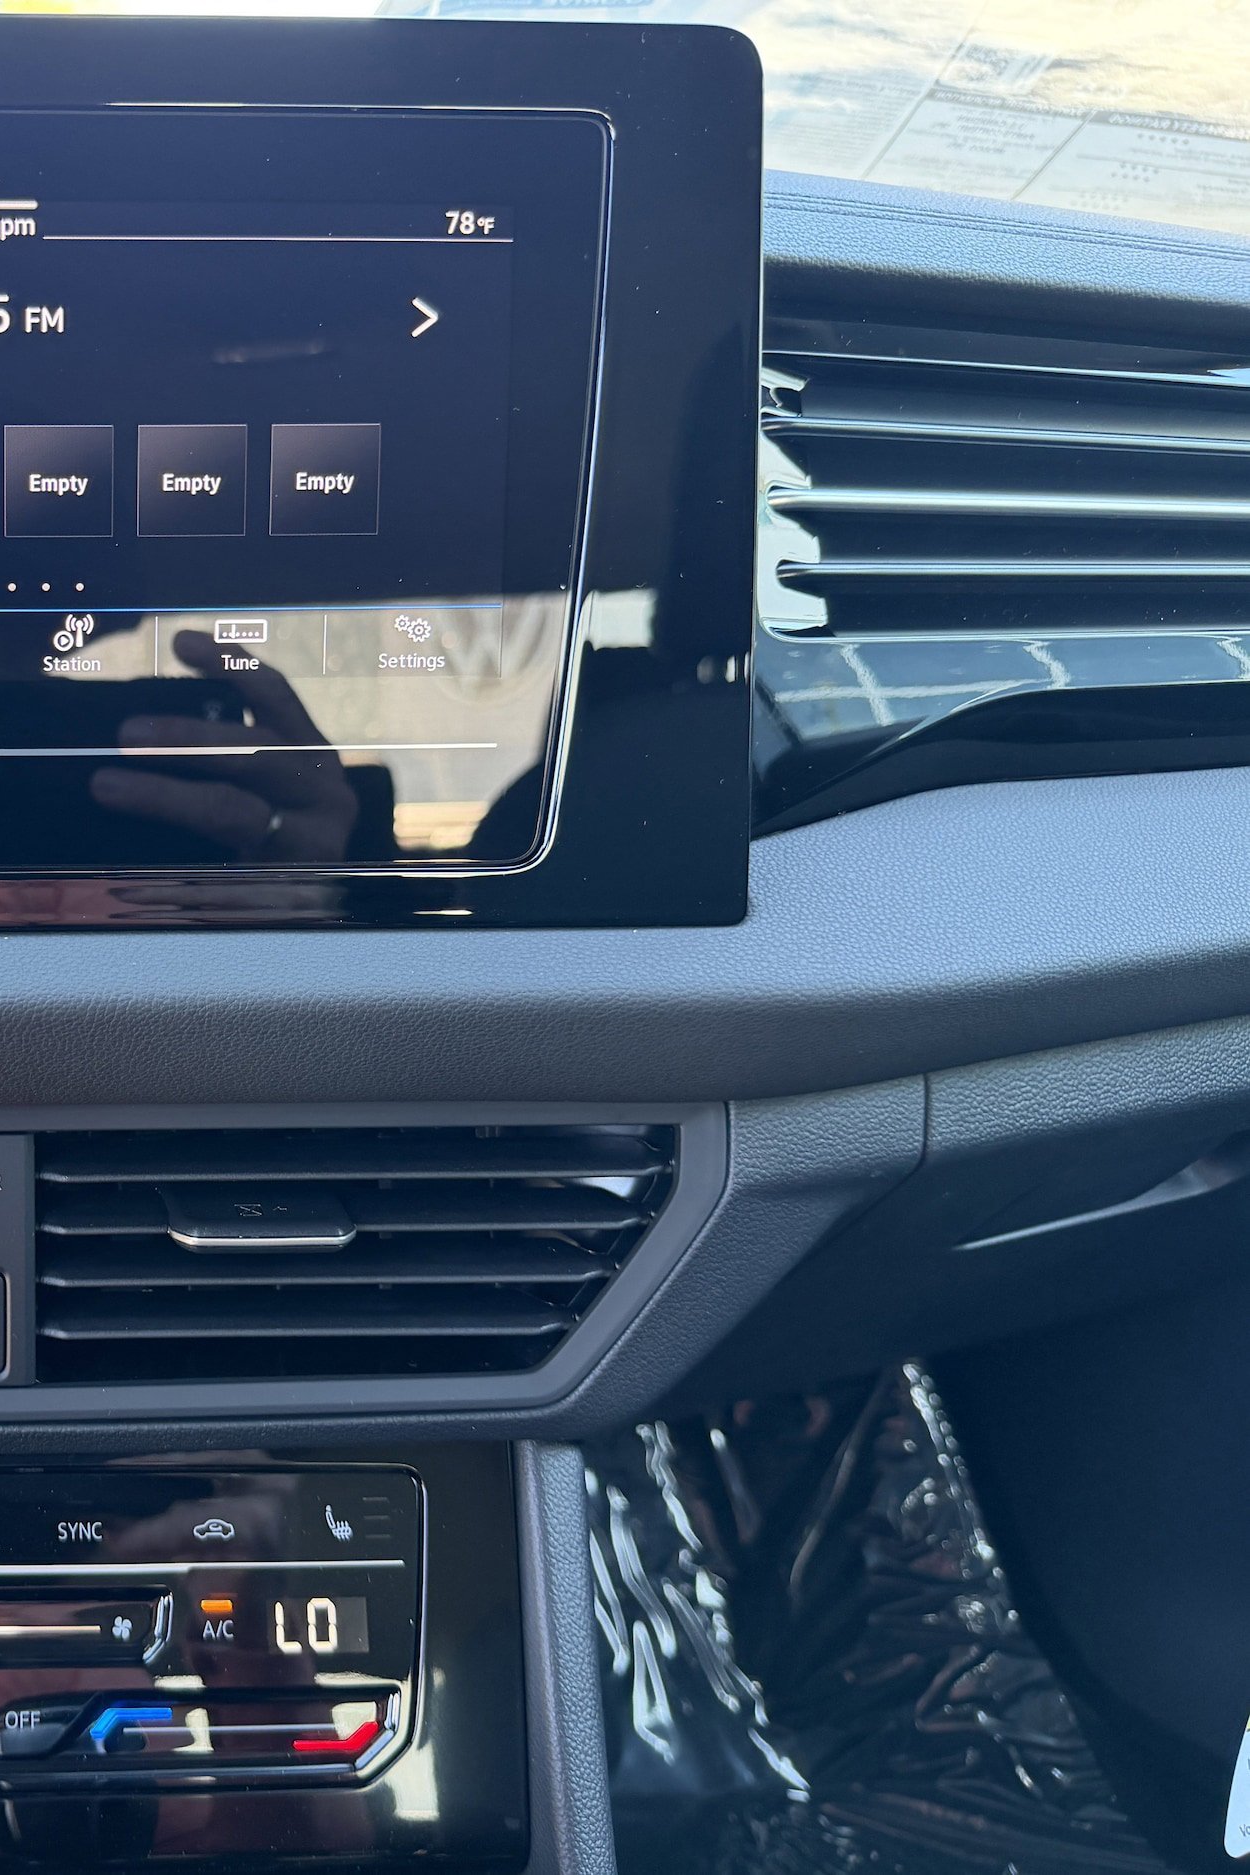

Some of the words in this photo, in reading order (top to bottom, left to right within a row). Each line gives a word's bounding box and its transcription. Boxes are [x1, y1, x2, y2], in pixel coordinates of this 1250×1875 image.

[25, 306, 64, 333] FM
[29, 473, 89, 496] Empty
[162, 473, 222, 495] Empty
[295, 471, 355, 494] Empty
[43, 656, 101, 672] Station
[221, 654, 260, 671] Tune
[378, 652, 445, 672] Settings
[57, 1521, 103, 1540] SYNC
[202, 1619, 234, 1639] A/C
[275, 1597, 338, 1654] LO
[5, 1710, 41, 1730] OFF
